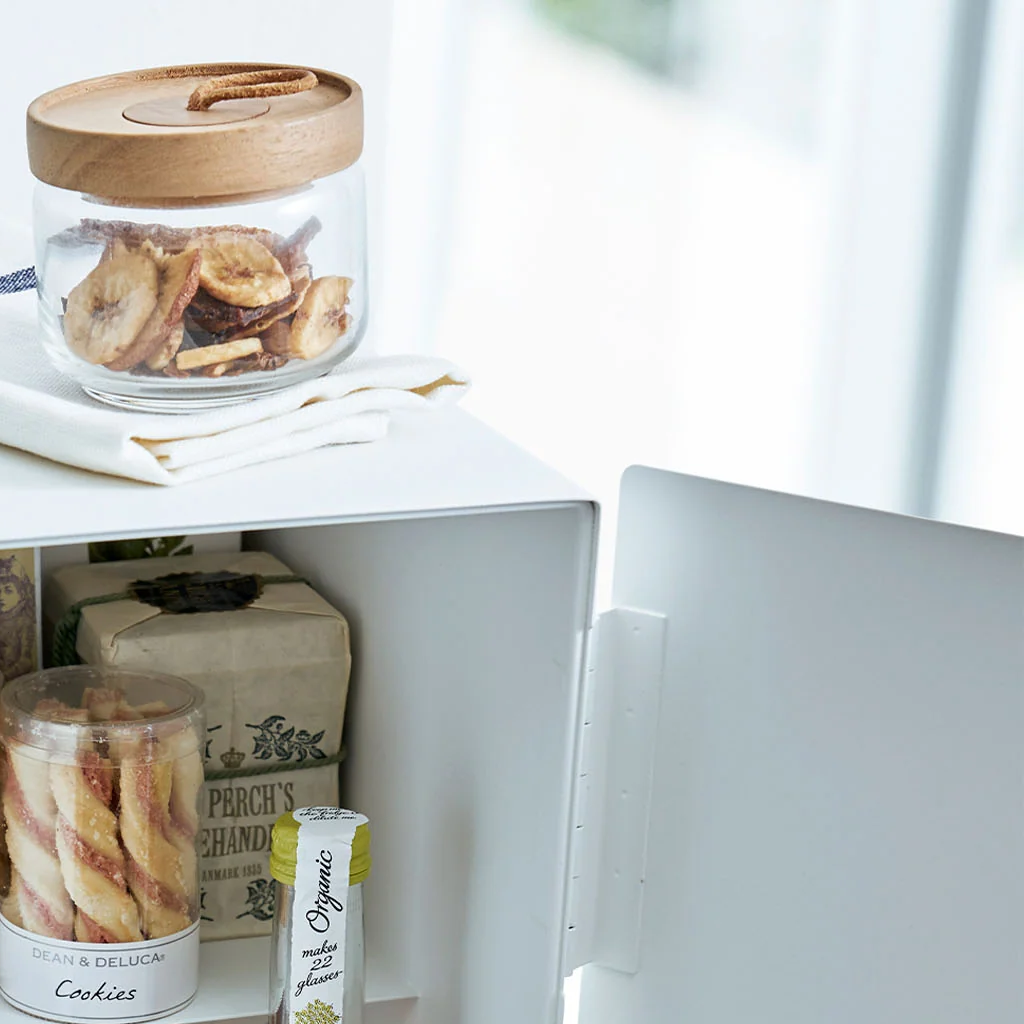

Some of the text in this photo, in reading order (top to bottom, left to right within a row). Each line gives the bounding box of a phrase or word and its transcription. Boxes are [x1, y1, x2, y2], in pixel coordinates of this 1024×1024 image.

[208, 782, 295, 819] PERCH'S
[306, 849, 343, 933] Organic
[32, 947, 74, 966] DEAN
[79, 956, 90, 967] &
[302, 940, 338, 958] makes
[310, 956, 333, 971] 22
[55, 979, 137, 1001] Cookies
[294, 970, 343, 997] glasses
